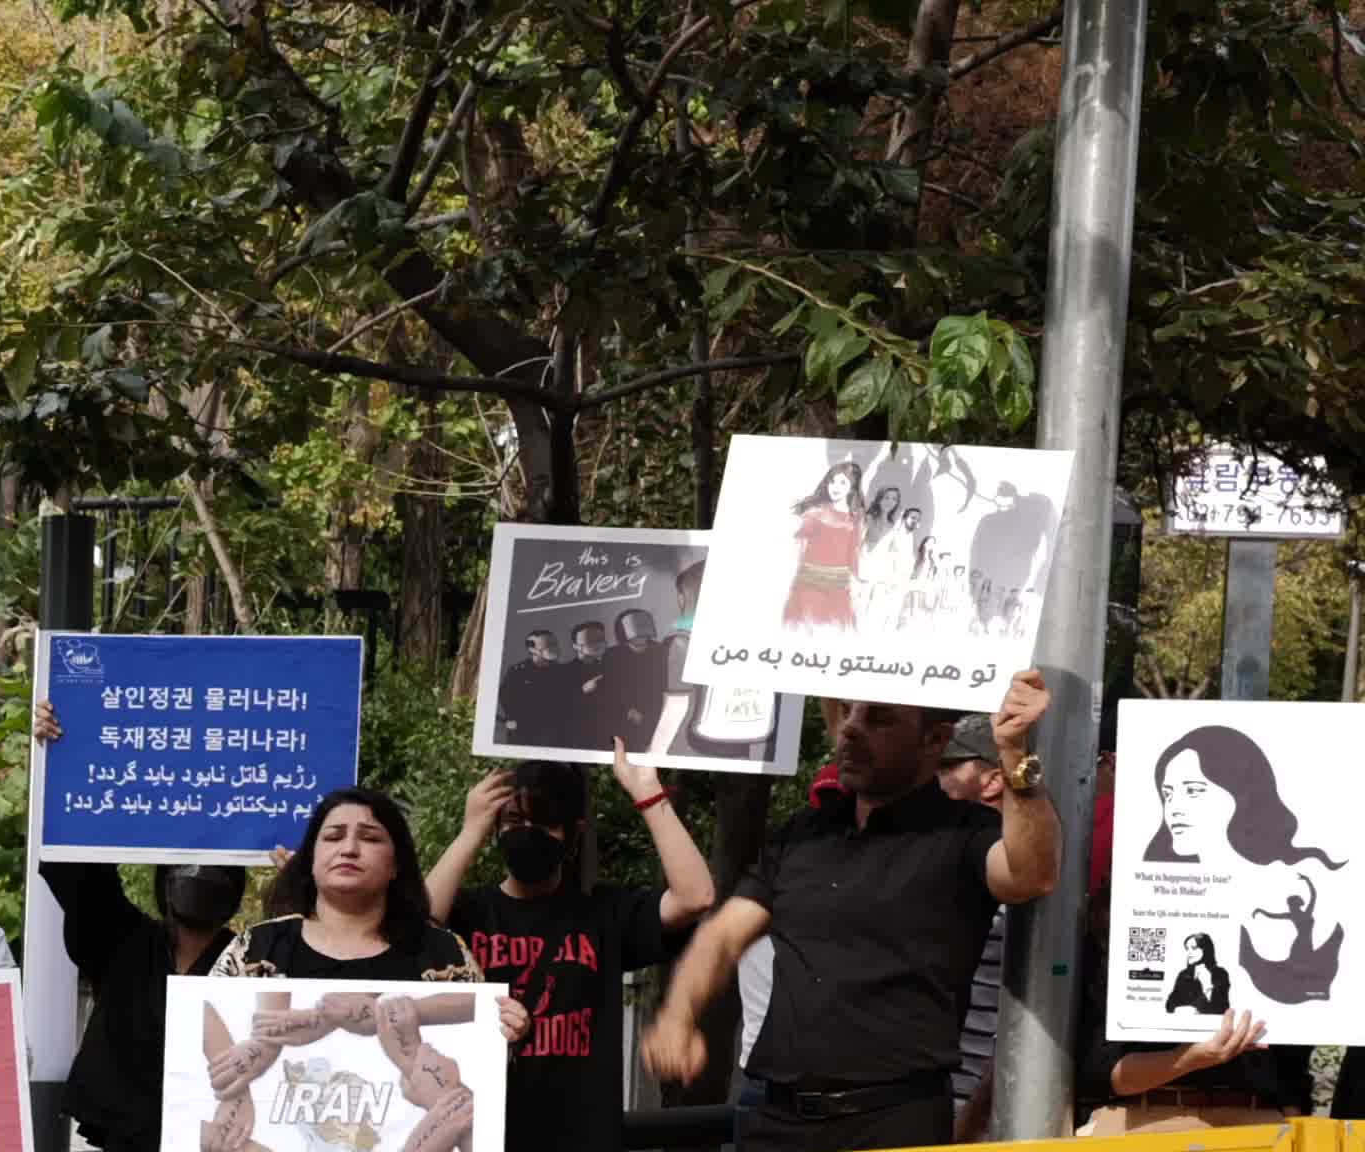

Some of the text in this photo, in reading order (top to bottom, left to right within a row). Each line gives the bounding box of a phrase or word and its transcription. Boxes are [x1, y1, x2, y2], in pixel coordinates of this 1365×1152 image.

[578, 547, 642, 566] this is
[527, 562, 648, 601] Bravery
[711, 644, 749, 665] من
[758, 648, 783, 666] به
[791, 651, 831, 670] بده
[921, 665, 961, 687] هم
[971, 663, 995, 689] تو
[101, 686, 308, 712] 살인정권 물러나라!
[98, 726, 307, 752] 독재정권 물러나라!
[144, 764, 175, 785] باید
[181, 765, 225, 786] نابود
[231, 765, 268, 788] قاتل
[272, 767, 316, 790] رژیم
[121, 793, 151, 815] باید
[158, 793, 202, 817] نابود
[209, 794, 288, 819] دیکتاتور
[269, 1081, 393, 1126] IRAN
